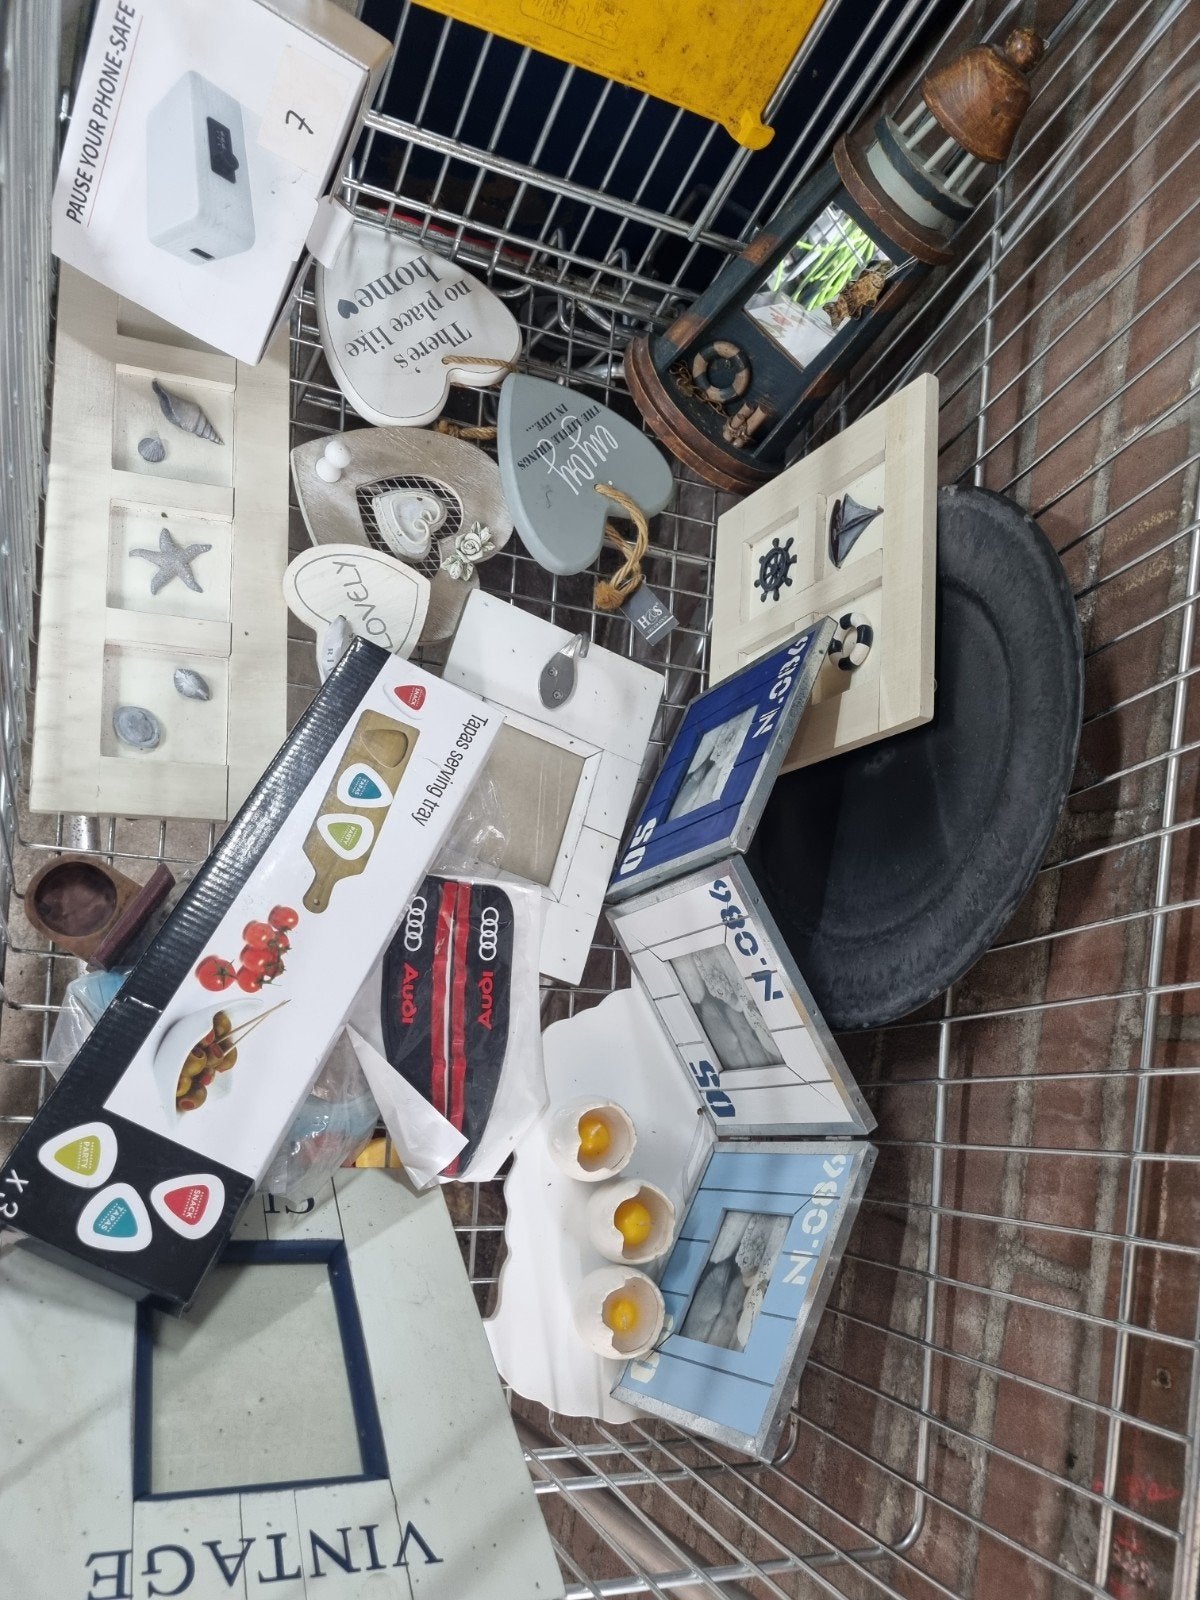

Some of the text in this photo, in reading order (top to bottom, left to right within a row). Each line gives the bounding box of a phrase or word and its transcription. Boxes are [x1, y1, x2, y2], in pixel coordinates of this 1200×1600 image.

[66, 0, 136, 224] PAUSE YOUR PHONE-SAFE
[285, 109, 314, 135] 7
[353, 255, 443, 308] home
[345, 280, 472, 357] no place like
[393, 320, 473, 374] There's
[555, 403, 569, 416] IN
[517, 405, 602, 471] THE LITTLE THINGS
[332, 561, 394, 650] LOVELY
[411, 714, 489, 827] Tapas serving tray
[80, 1141, 91, 1169] PARTY
[101, 1205, 125, 1231] TAPAS
[185, 1189, 201, 1218] SNACK
[85, 1520, 445, 1600] VINTAGE
